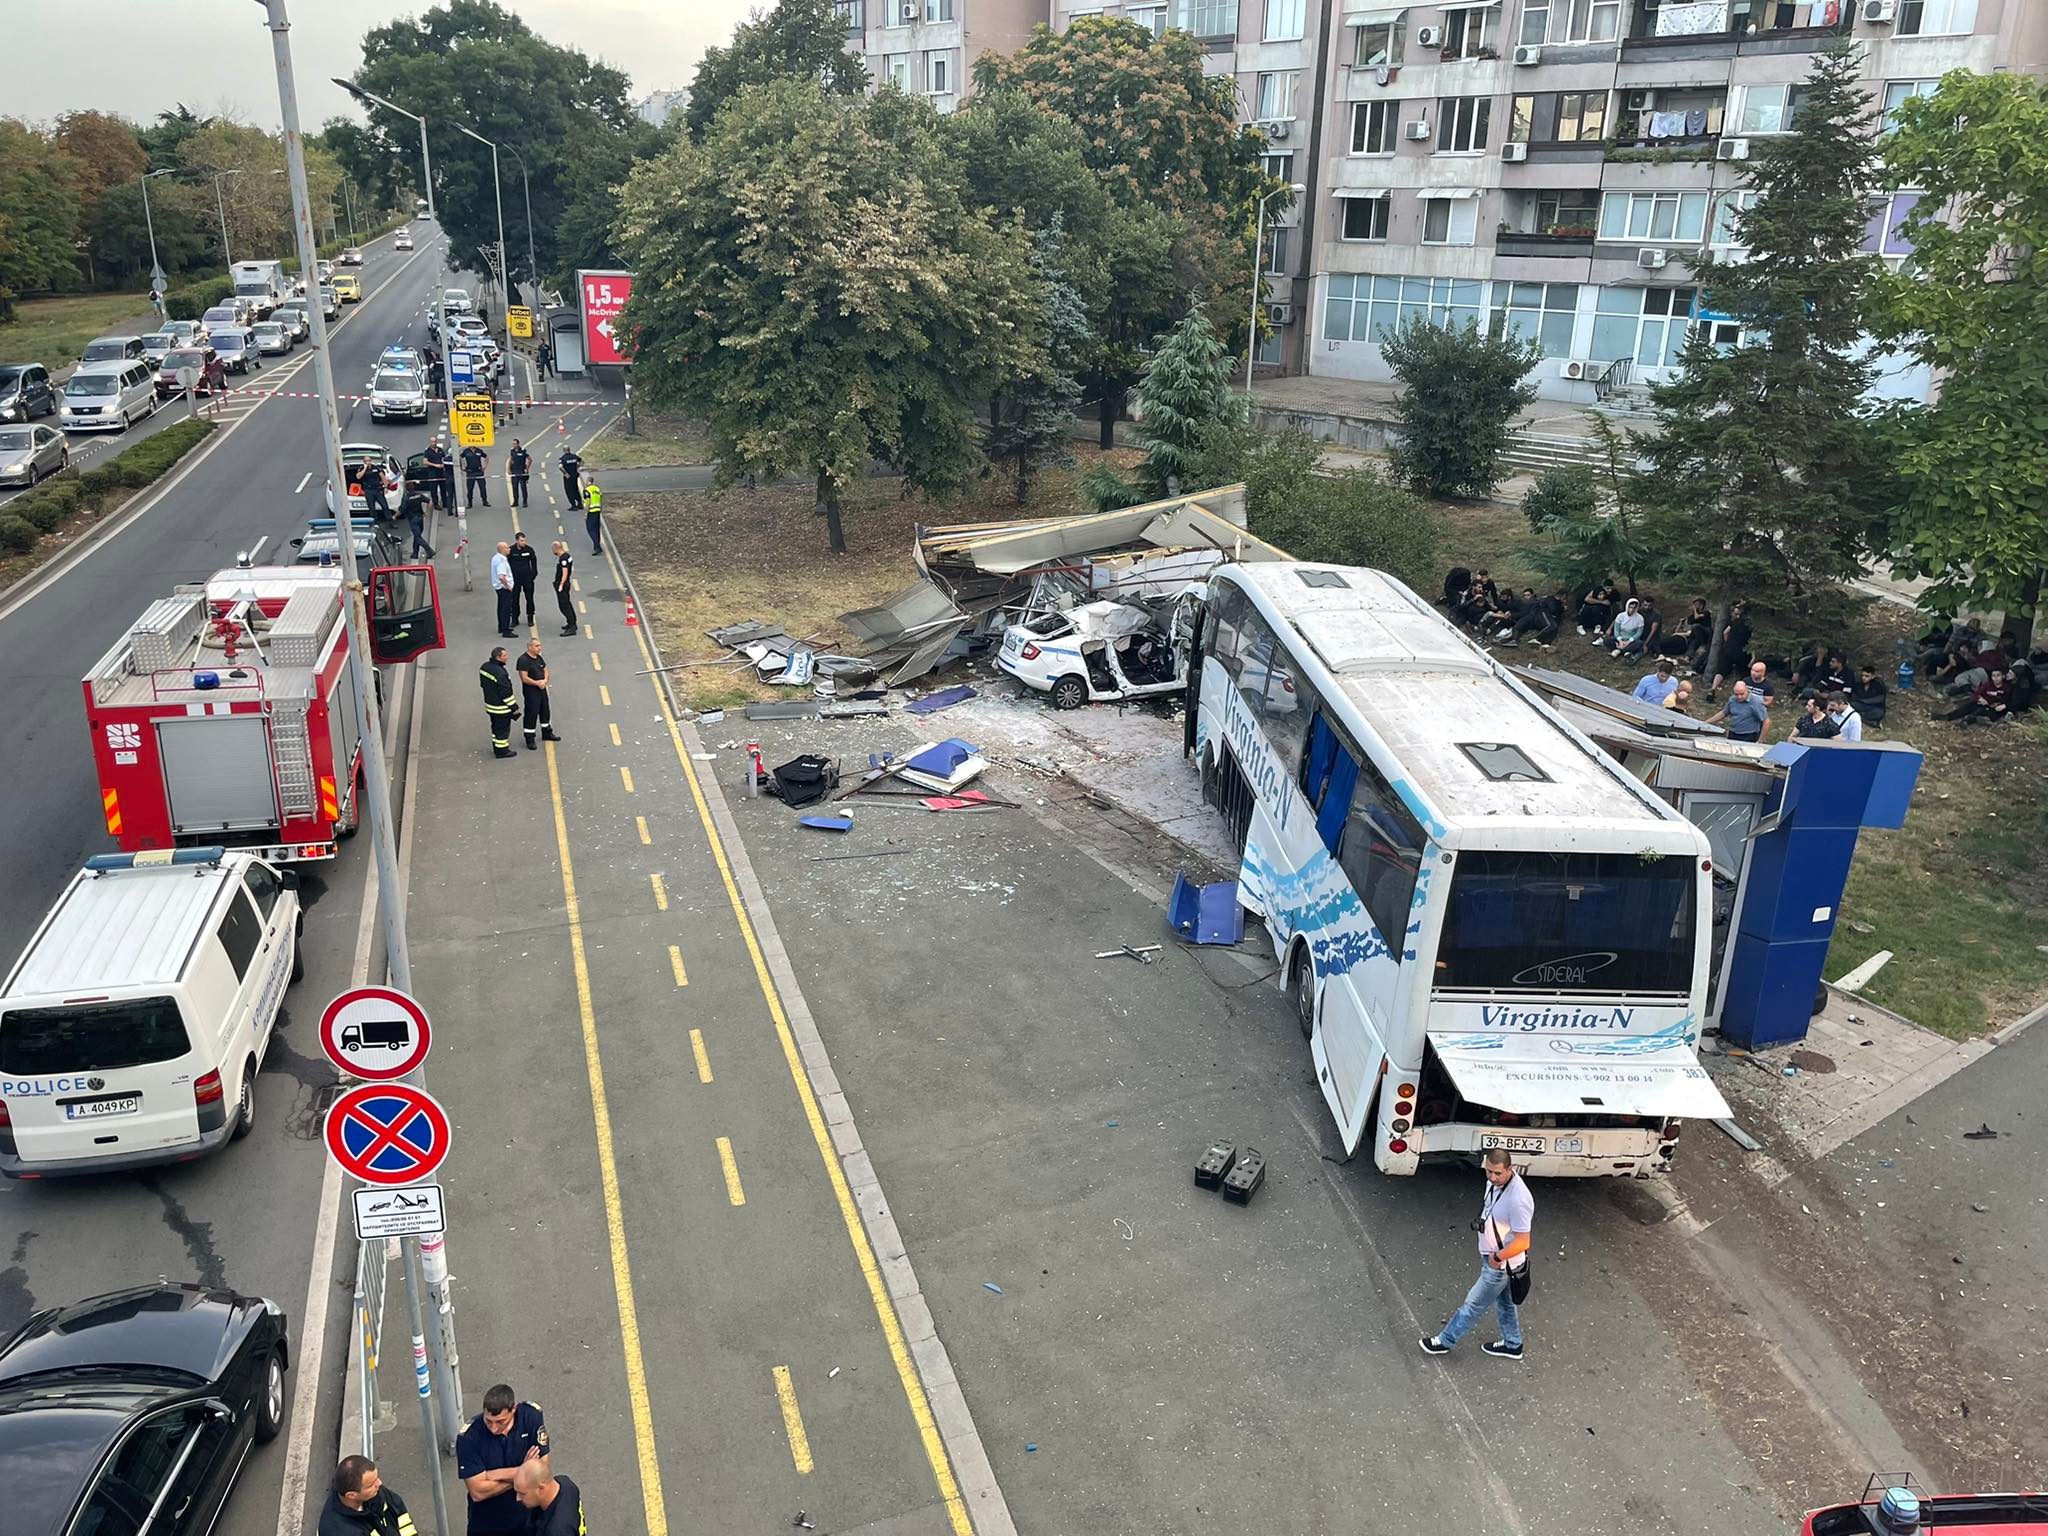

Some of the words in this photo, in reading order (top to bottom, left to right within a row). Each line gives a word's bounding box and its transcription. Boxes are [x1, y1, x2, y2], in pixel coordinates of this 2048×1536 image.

[586, 284, 611, 308] 1,5
[458, 402, 490, 411] efbet
[1224, 676, 1295, 832] Virginia-N
[1537, 966, 1587, 983] SIDERAL
[1482, 1005, 1635, 1032] Virginia-N
[1682, 1068, 1706, 1079] 383
[2, 1078, 87, 1094] POLICE
[1485, 1137, 1542, 1150] 39-BFX-2
